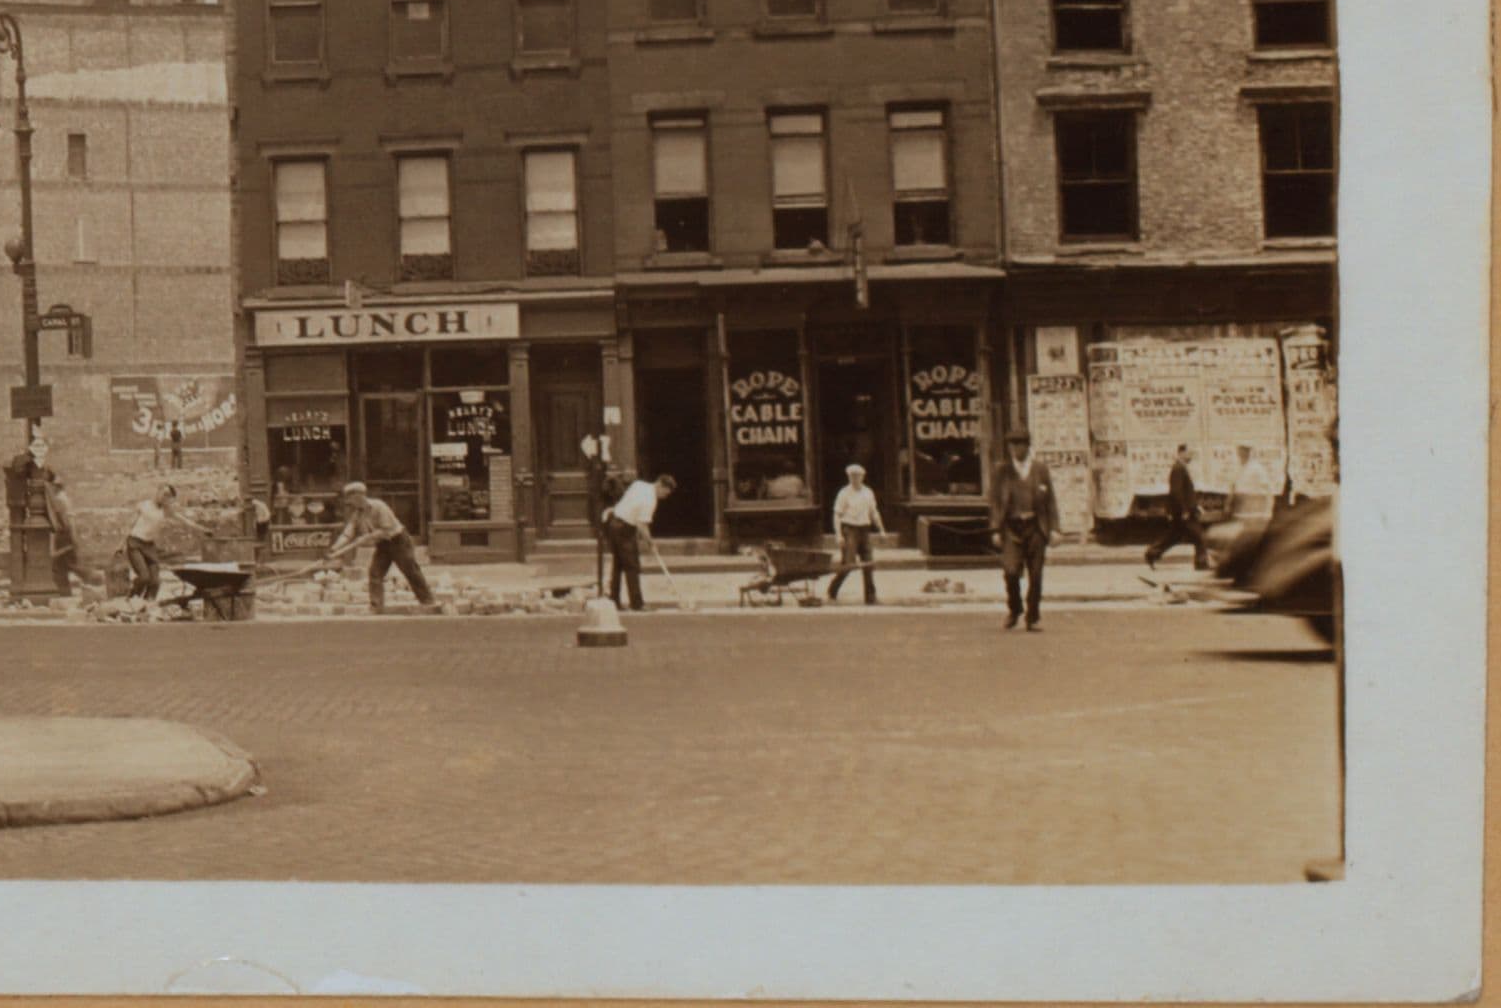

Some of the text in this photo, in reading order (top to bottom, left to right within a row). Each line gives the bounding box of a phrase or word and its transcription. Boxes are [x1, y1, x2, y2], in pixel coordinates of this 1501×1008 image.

[42, 318, 68, 327] CANAL
[295, 310, 469, 339] LUNCH
[732, 371, 800, 398] ROPE
[913, 365, 982, 391] ROPE
[911, 398, 983, 417] CABLE
[1131, 397, 1195, 407] POWELL
[1211, 395, 1276, 406] POWELL
[731, 403, 803, 422] CABLE
[283, 426, 331, 441] LUNCH
[447, 421, 497, 437] LUNCH
[737, 426, 798, 445] CHAIN
[915, 420, 982, 440] CHAIN
